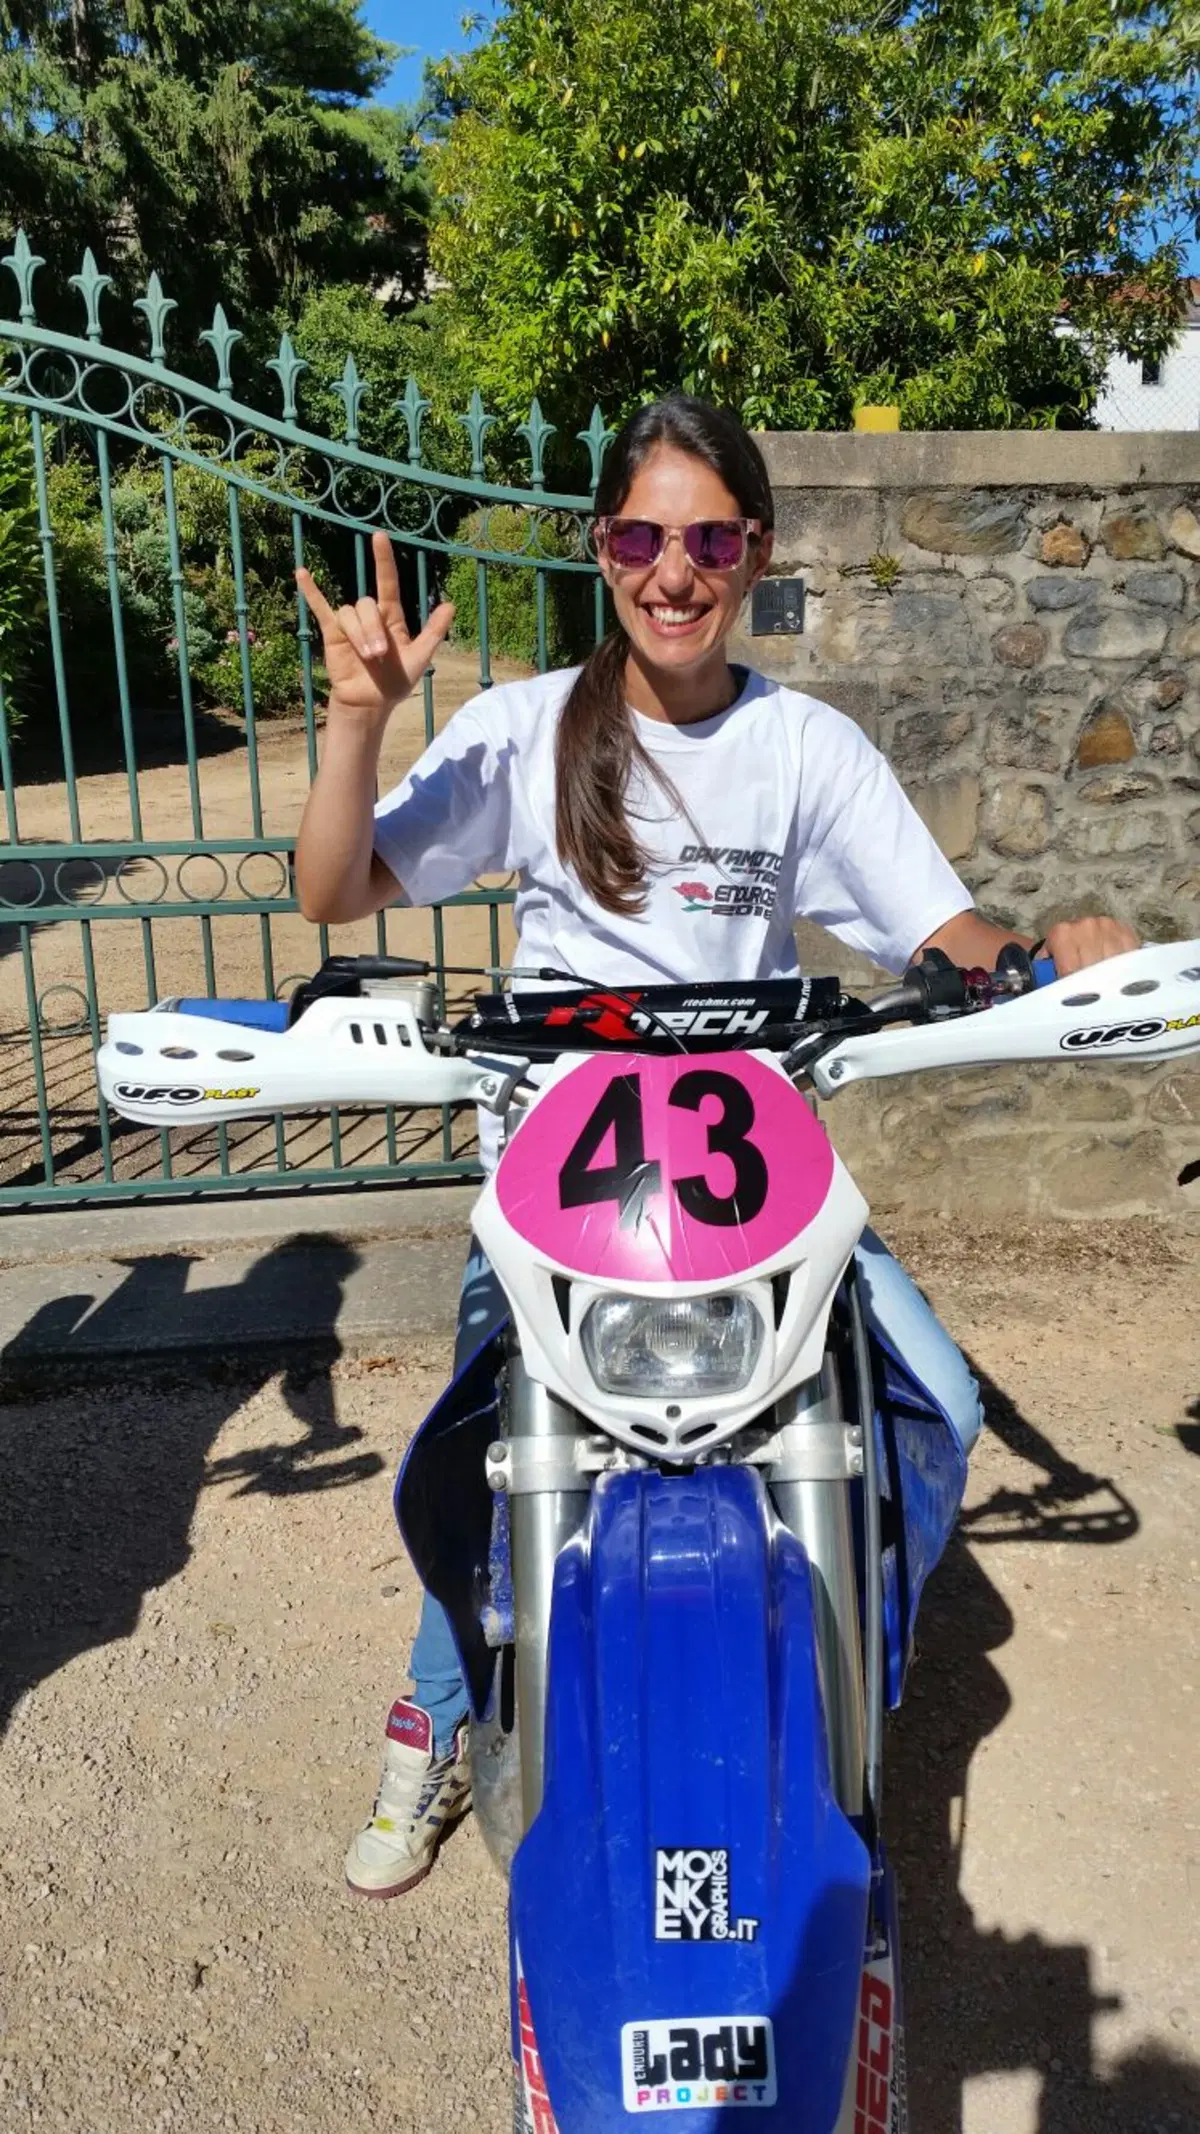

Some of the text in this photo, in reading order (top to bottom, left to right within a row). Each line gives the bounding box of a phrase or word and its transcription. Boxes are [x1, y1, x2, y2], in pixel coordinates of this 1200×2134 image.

[682, 997, 756, 1007] rtechmx.com
[1063, 1019, 1166, 1049] UFO
[115, 1083, 259, 1104] UFO PLAST
[558, 1069, 769, 1229] 43
[711, 1850, 728, 1940] GRAPHICS
[636, 2026, 769, 2088] Lady
[637, 2086, 767, 2106] PROJECT
